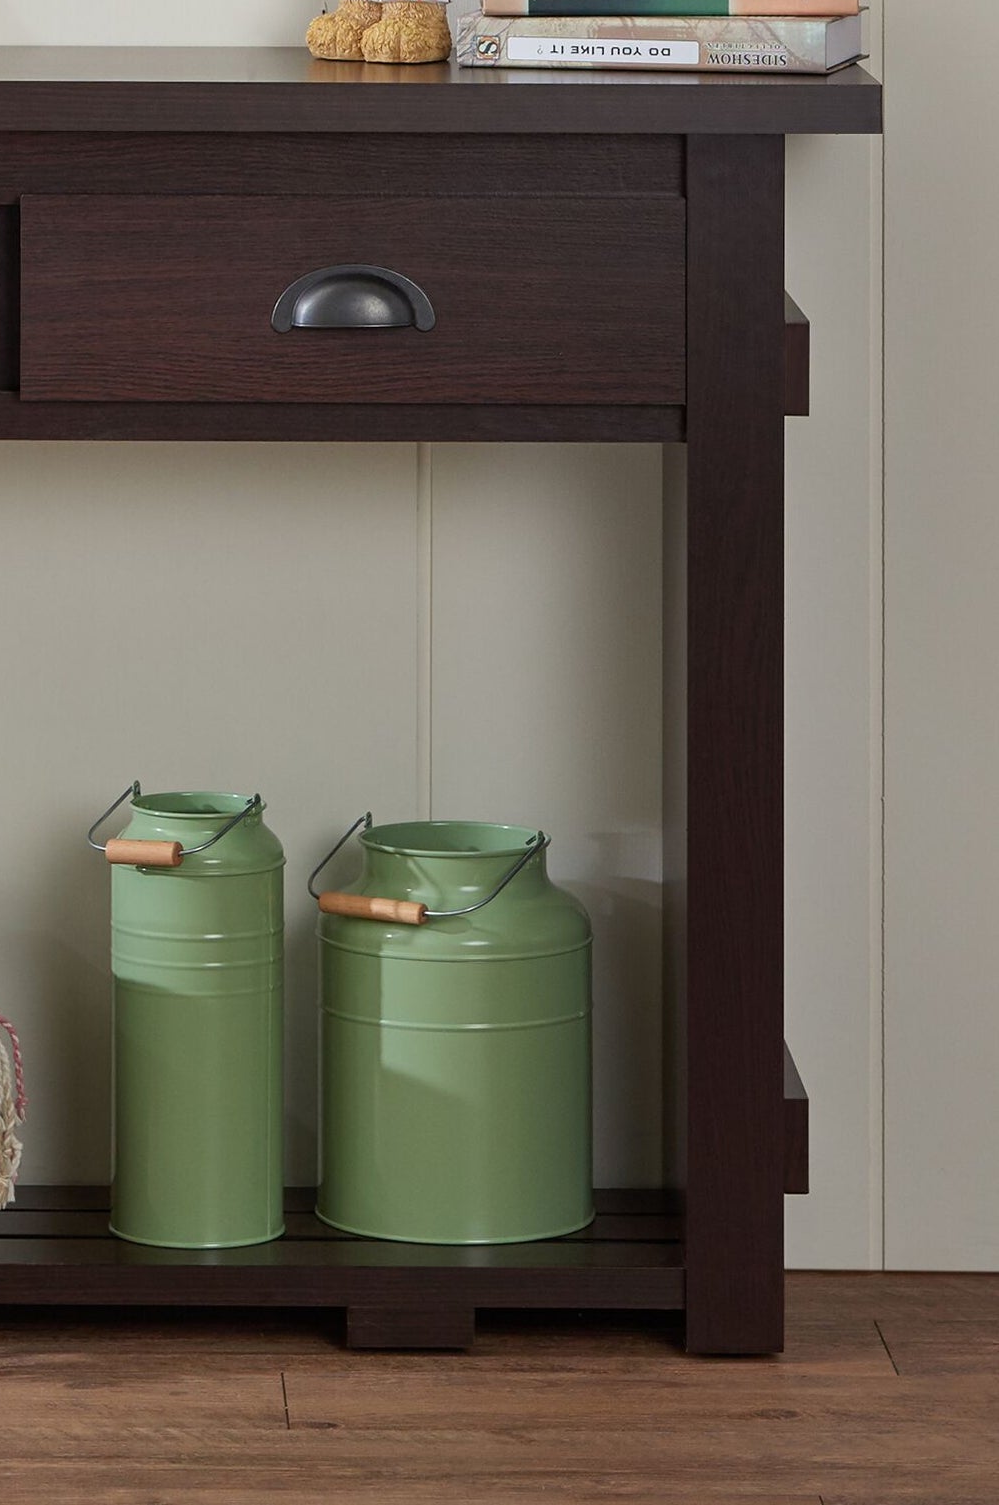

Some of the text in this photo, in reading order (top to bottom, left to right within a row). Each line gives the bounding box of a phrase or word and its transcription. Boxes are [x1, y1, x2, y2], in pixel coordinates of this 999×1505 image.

[550, 44, 564, 55] IT
[571, 45, 605, 56] LIKE
[611, 46, 642, 56] YOU
[649, 47, 671, 56] DO
[707, 53, 787, 66] SIDESHOW
